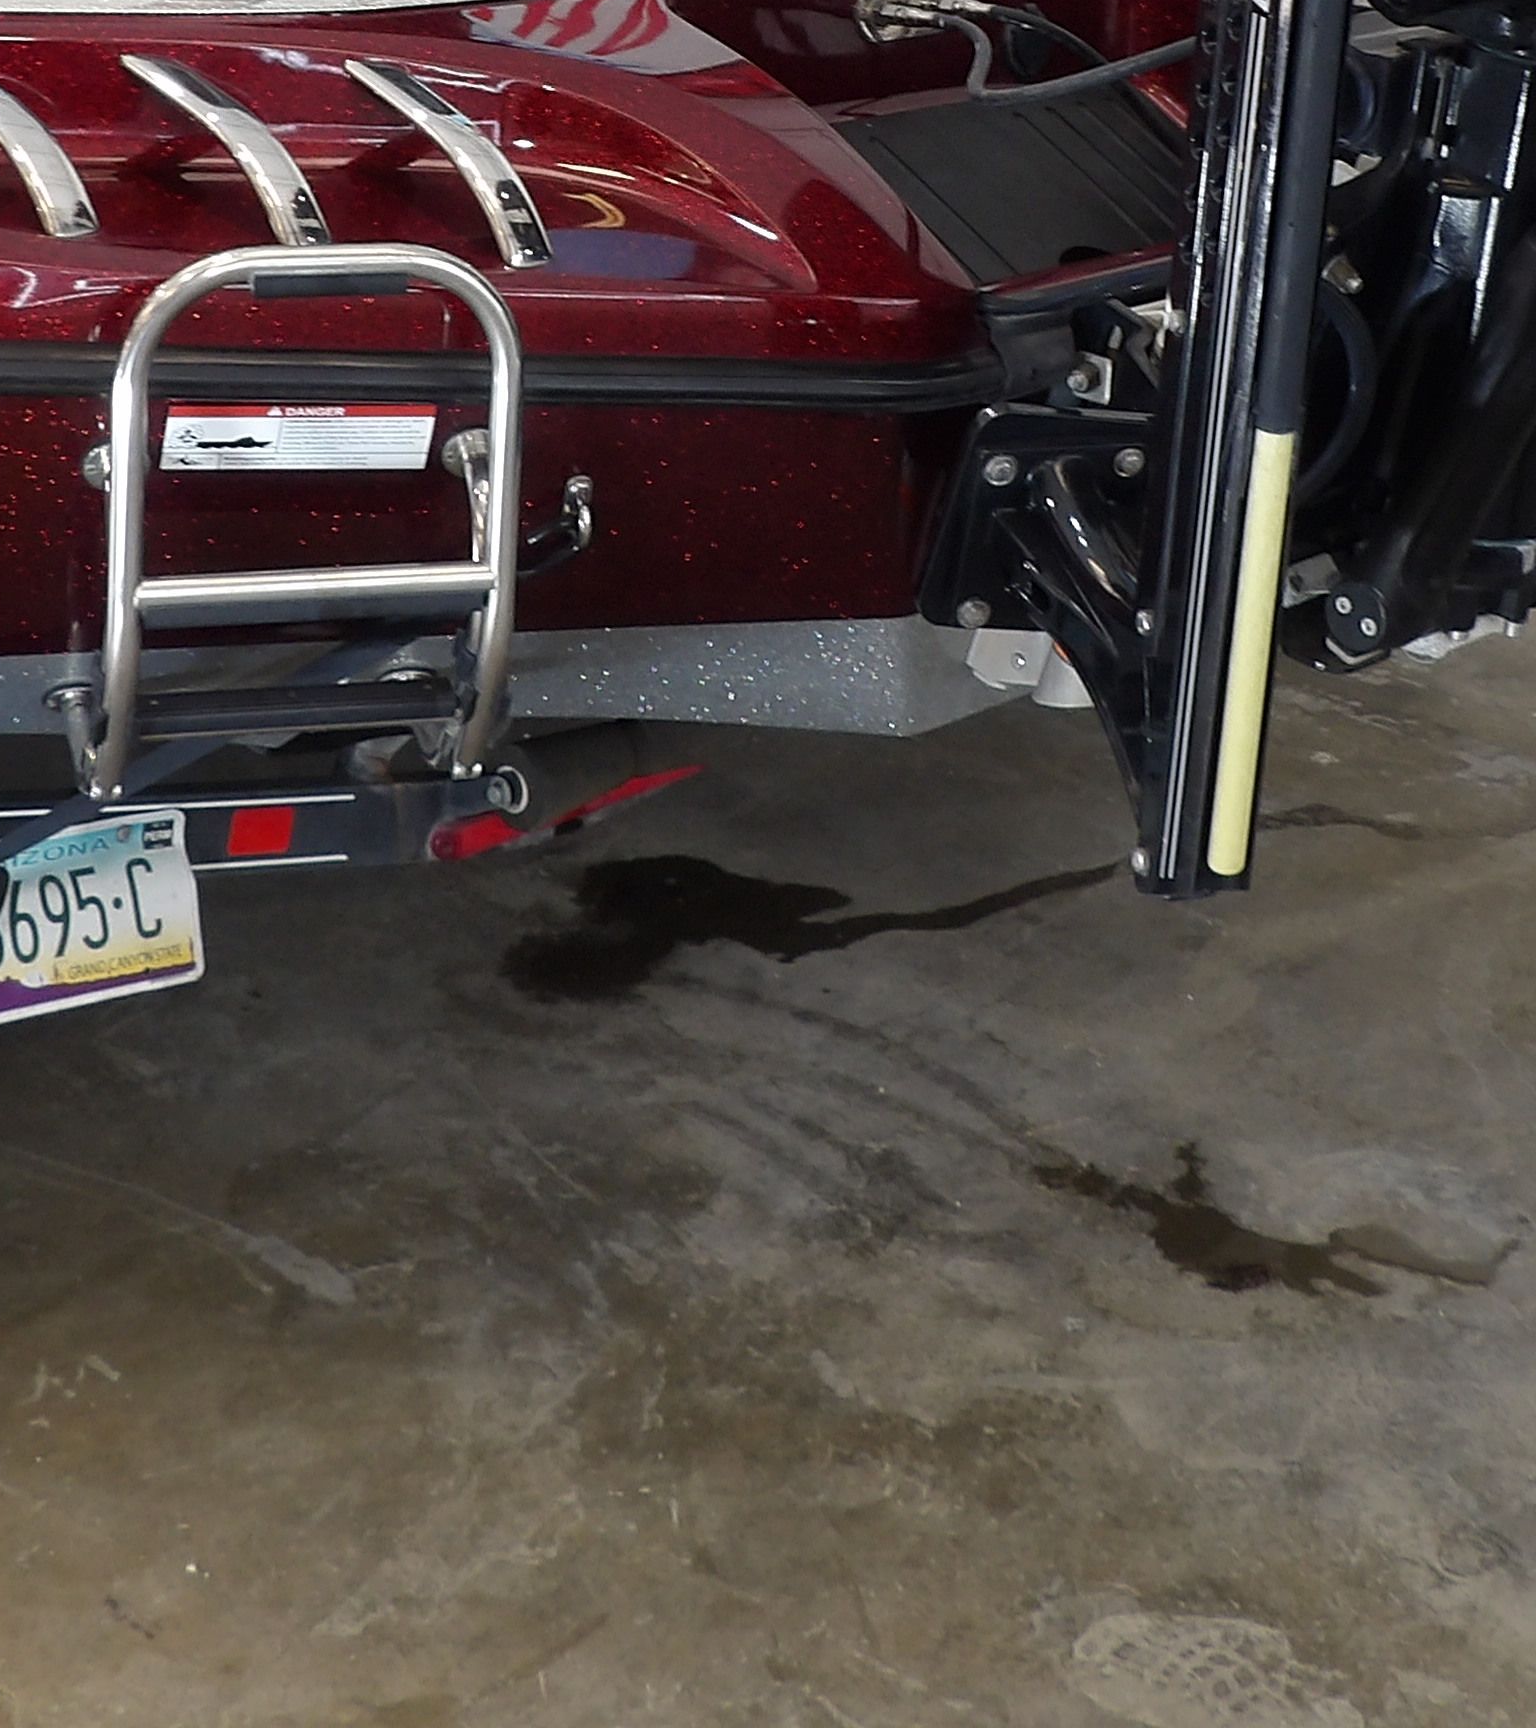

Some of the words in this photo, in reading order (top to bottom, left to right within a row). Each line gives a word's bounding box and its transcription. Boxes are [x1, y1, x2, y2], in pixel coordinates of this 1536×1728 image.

[284, 406, 346, 418] DANGER
[13, 836, 110, 866] IZONA
[69, 960, 106, 980] GRAND
[108, 951, 154, 972] CANYON
